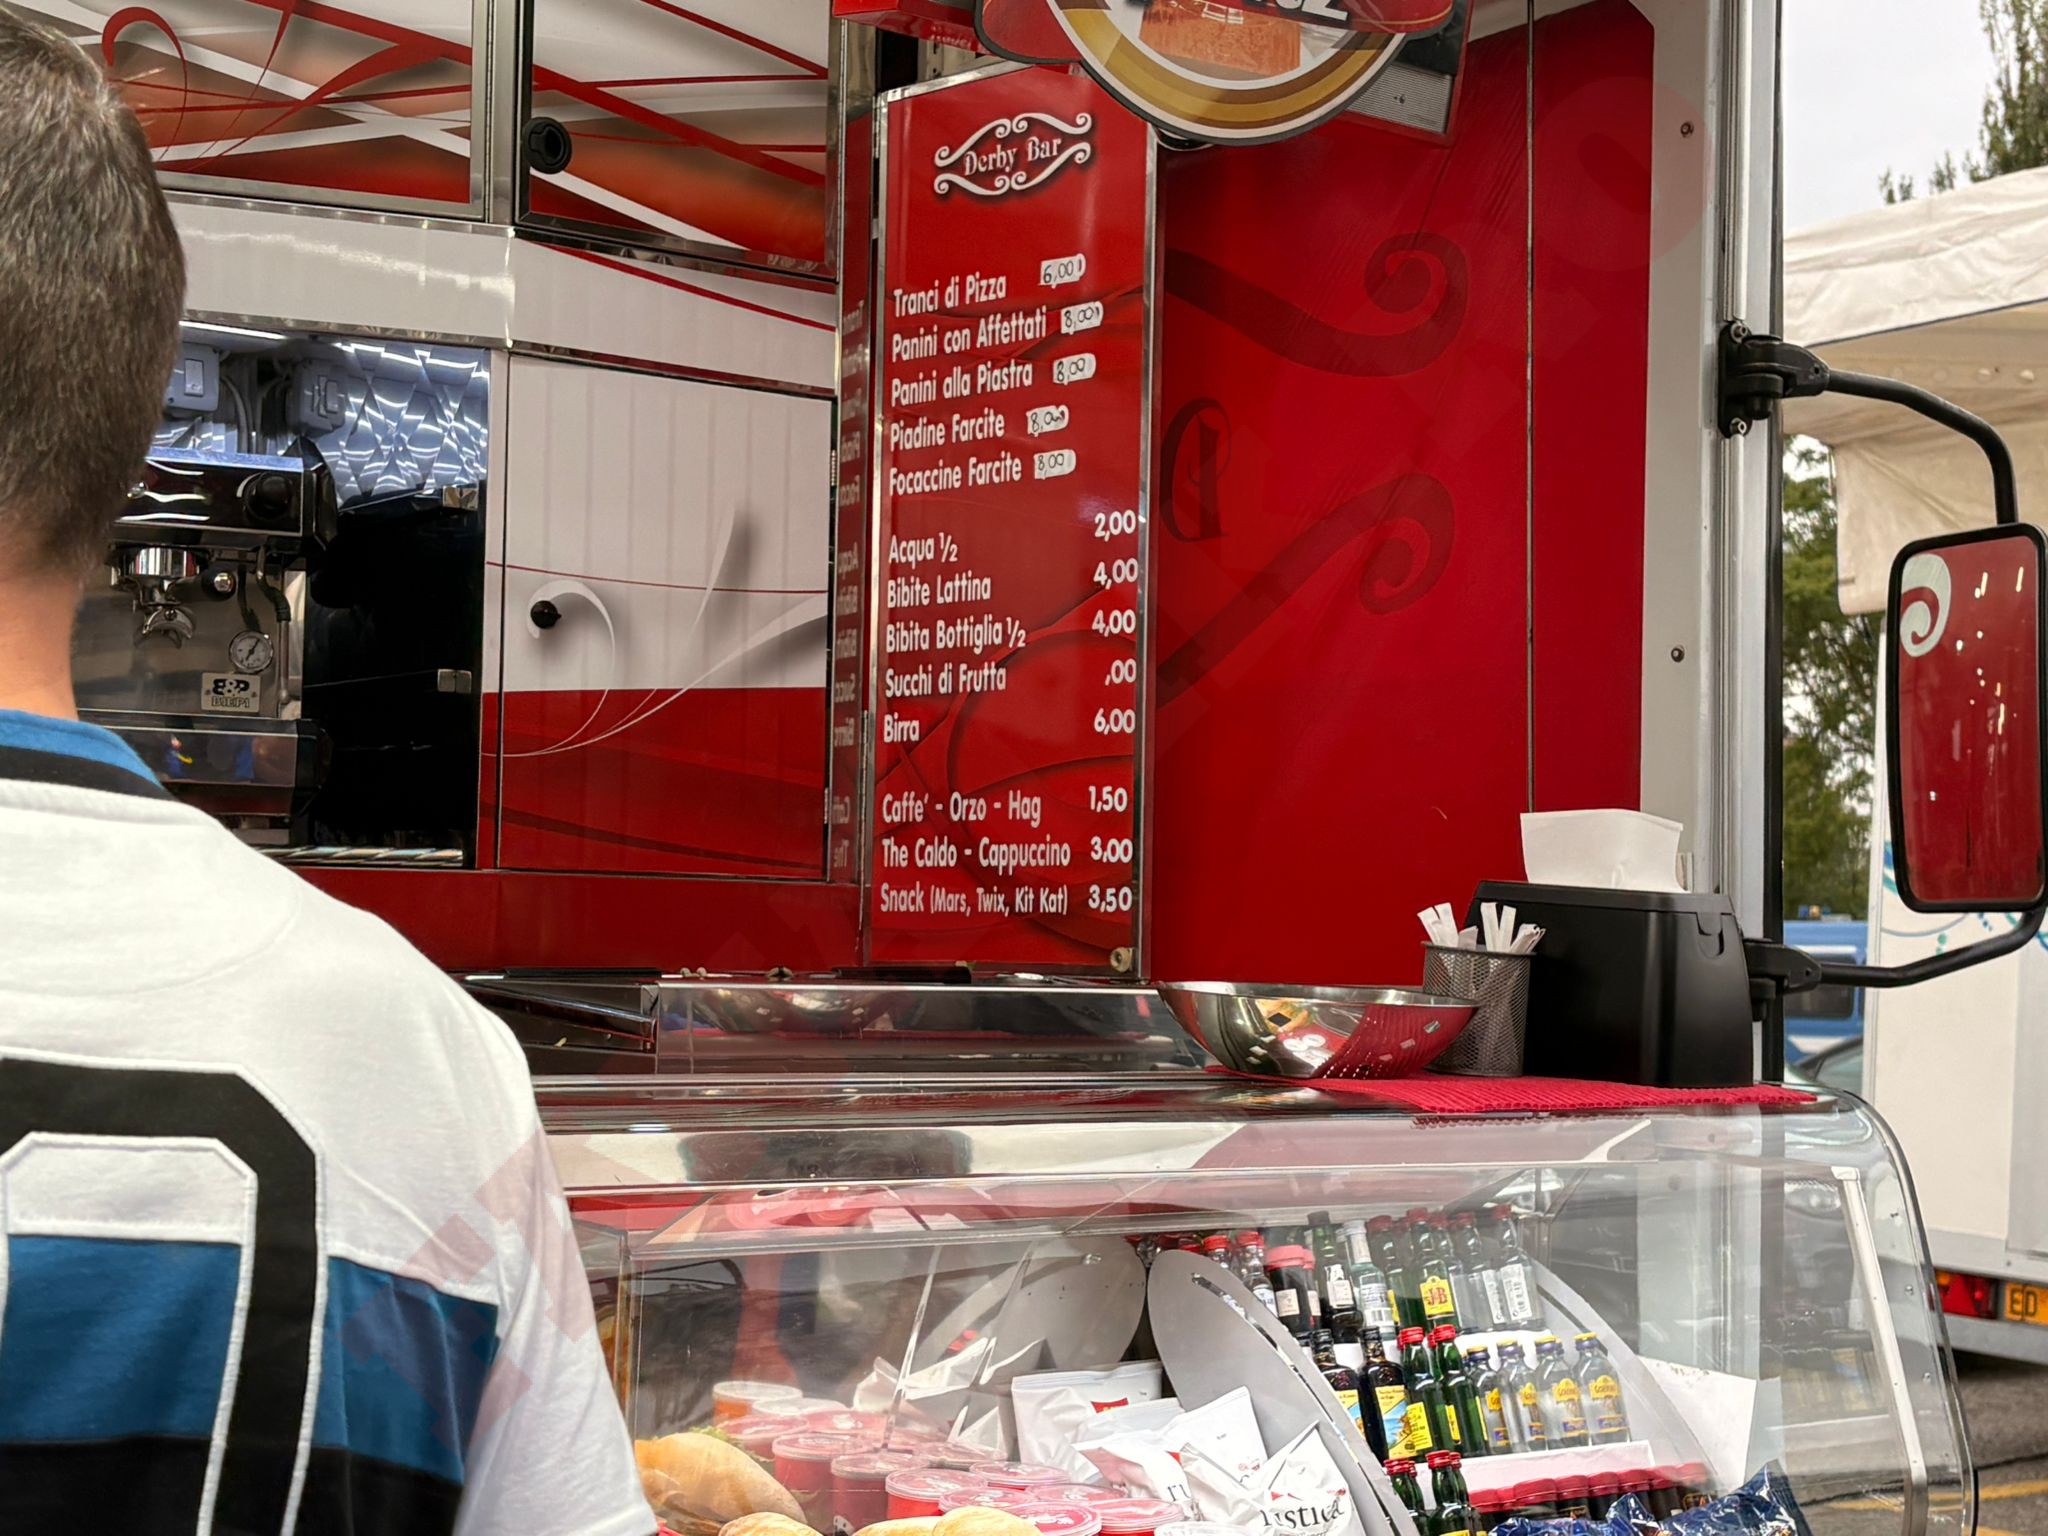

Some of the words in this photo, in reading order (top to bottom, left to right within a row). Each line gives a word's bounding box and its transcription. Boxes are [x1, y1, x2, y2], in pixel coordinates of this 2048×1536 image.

[964, 144, 1018, 175] Derby
[1027, 136, 1061, 161] Bar
[894, 280, 939, 317] Tranci
[944, 275, 959, 307] di
[965, 272, 1006, 304] Pizza
[892, 324, 937, 362] Panini
[943, 327, 970, 353] con
[977, 305, 1047, 348] Affettati
[891, 370, 937, 407] Panini
[943, 366, 970, 398] alla
[977, 358, 1032, 394] Piastra
[890, 418, 945, 452] Piadine
[952, 407, 1005, 443] Farcite
[889, 459, 962, 497] Focaccine
[968, 450, 1022, 487] Farcite
[888, 535, 935, 569] Acqua
[1094, 510, 1136, 542] 2,00
[887, 576, 930, 609] Bibite
[936, 570, 991, 605] Lattina
[1093, 558, 1138, 590] 4,00
[886, 621, 929, 653] Bibita
[936, 614, 1002, 654] Bottiglia
[1091, 609, 1136, 637] 4,00
[885, 664, 932, 698] Succhi
[938, 662, 952, 695] di
[959, 661, 1006, 692] Frutta
[883, 712, 920, 743] Birra
[1093, 708, 1136, 735] 6,00
[882, 791, 929, 823] Caffe'
[950, 791, 987, 822] Orzo
[1008, 790, 1041, 828] Hag
[1088, 785, 1128, 813] 1,50
[882, 836, 908, 868] The
[914, 835, 957, 868] Caldo
[978, 834, 1071, 876] Cappuccino
[1090, 836, 1133, 863] 3,00
[880, 881, 924, 913] Snack
[930, 884, 971, 917] (Mars,
[976, 885, 1009, 917] Twix,
[1015, 884, 1035, 914] Kit
[1040, 884, 1068, 916] Kat)
[1088, 884, 1132, 913] 3,50
